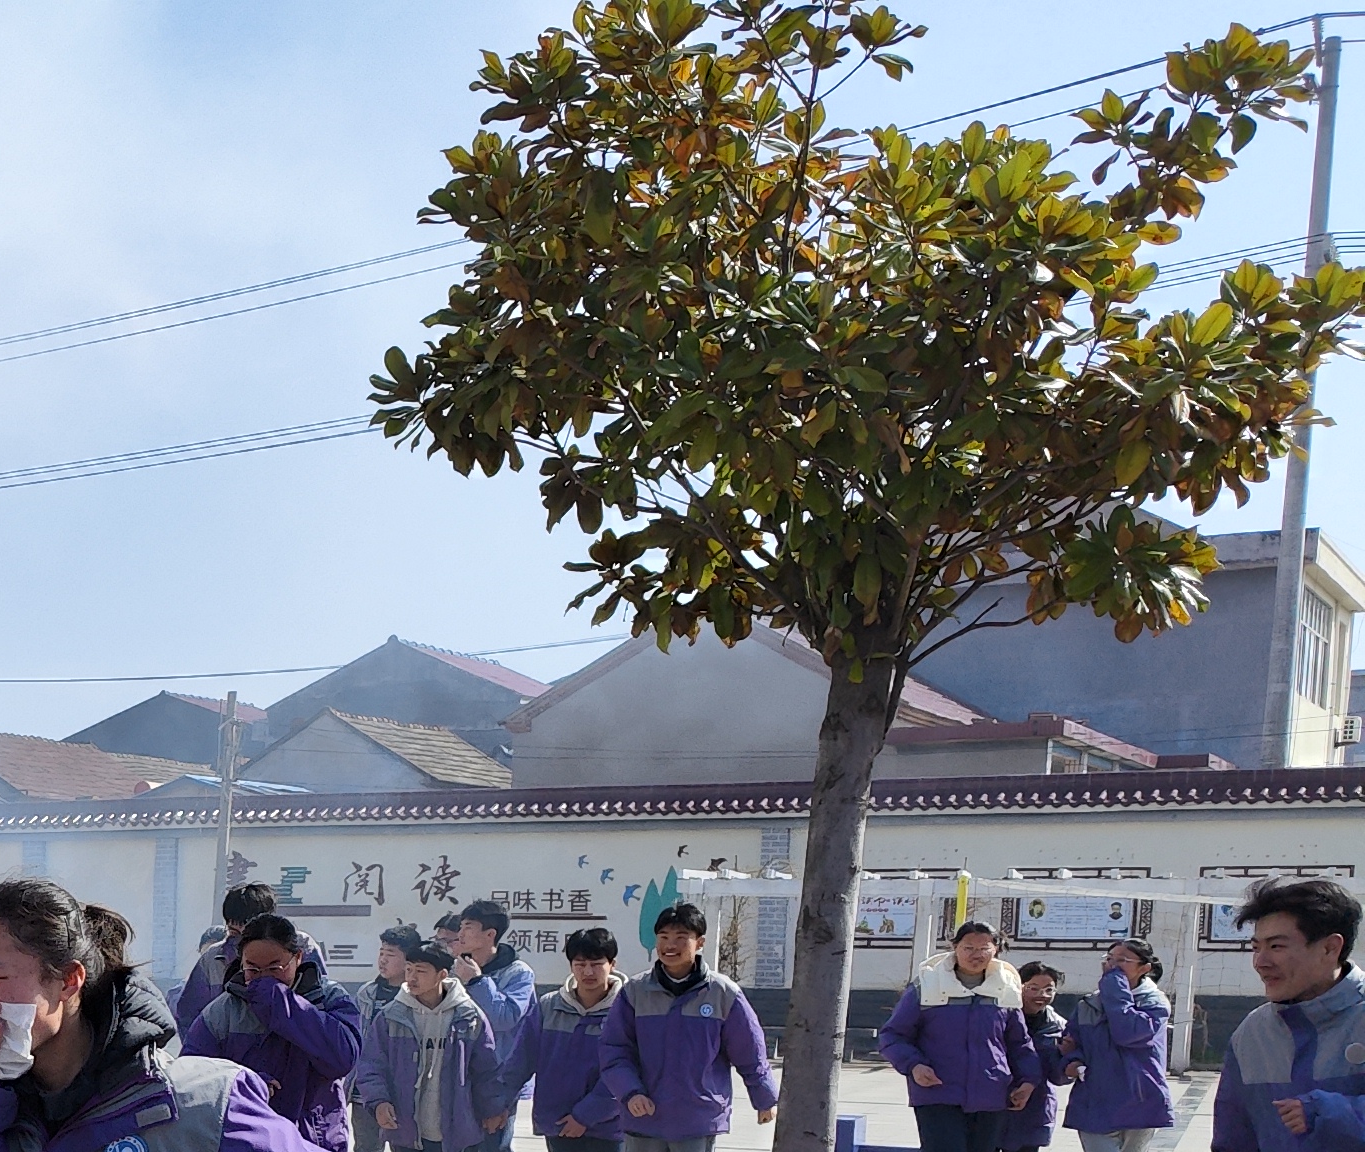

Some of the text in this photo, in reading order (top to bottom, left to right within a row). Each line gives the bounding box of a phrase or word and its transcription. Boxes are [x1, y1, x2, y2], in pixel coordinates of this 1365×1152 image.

[342, 854, 462, 906] 阅读
[491, 888, 592, 912] 品味书香
[506, 929, 572, 954] 领悟
